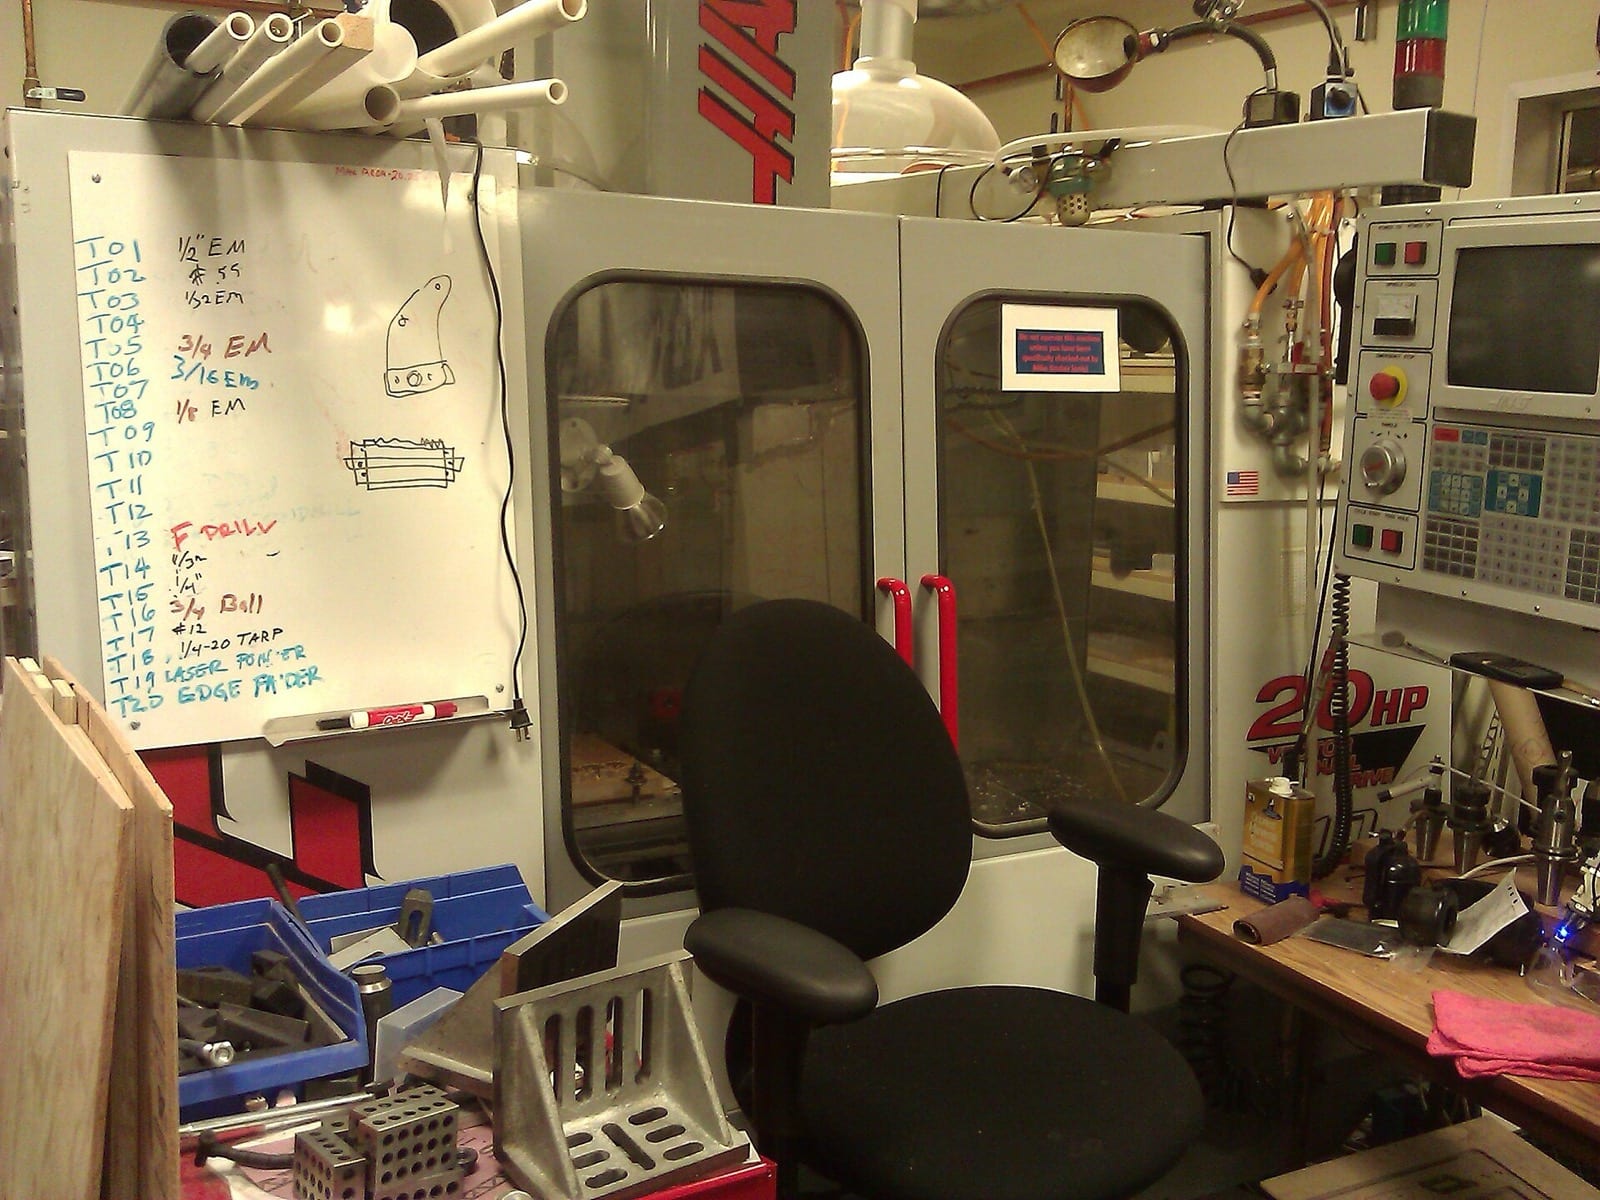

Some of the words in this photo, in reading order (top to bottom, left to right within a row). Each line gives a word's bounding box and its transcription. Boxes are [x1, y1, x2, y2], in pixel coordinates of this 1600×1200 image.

[75, 236, 141, 262] T01
[78, 260, 147, 286] T02
[78, 289, 140, 311] T03
[86, 313, 145, 334] T04
[178, 333, 211, 360] 3/4
[224, 331, 273, 359] EM
[86, 358, 140, 381] T06
[171, 354, 219, 385] 3/16
[90, 379, 149, 400] T07
[211, 397, 246, 417] EM
[94, 399, 137, 424] T08
[88, 421, 155, 447] T09
[94, 450, 152, 473] T10
[96, 474, 143, 499] T11
[104, 500, 153, 524] T12
[99, 557, 151, 586] T14
[100, 582, 154, 610] T15
[102, 603, 156, 632] T16
[106, 626, 155, 651] T17
[106, 649, 154, 673] T18
[110, 671, 156, 694] T19
[178, 679, 242, 704] EDGE
